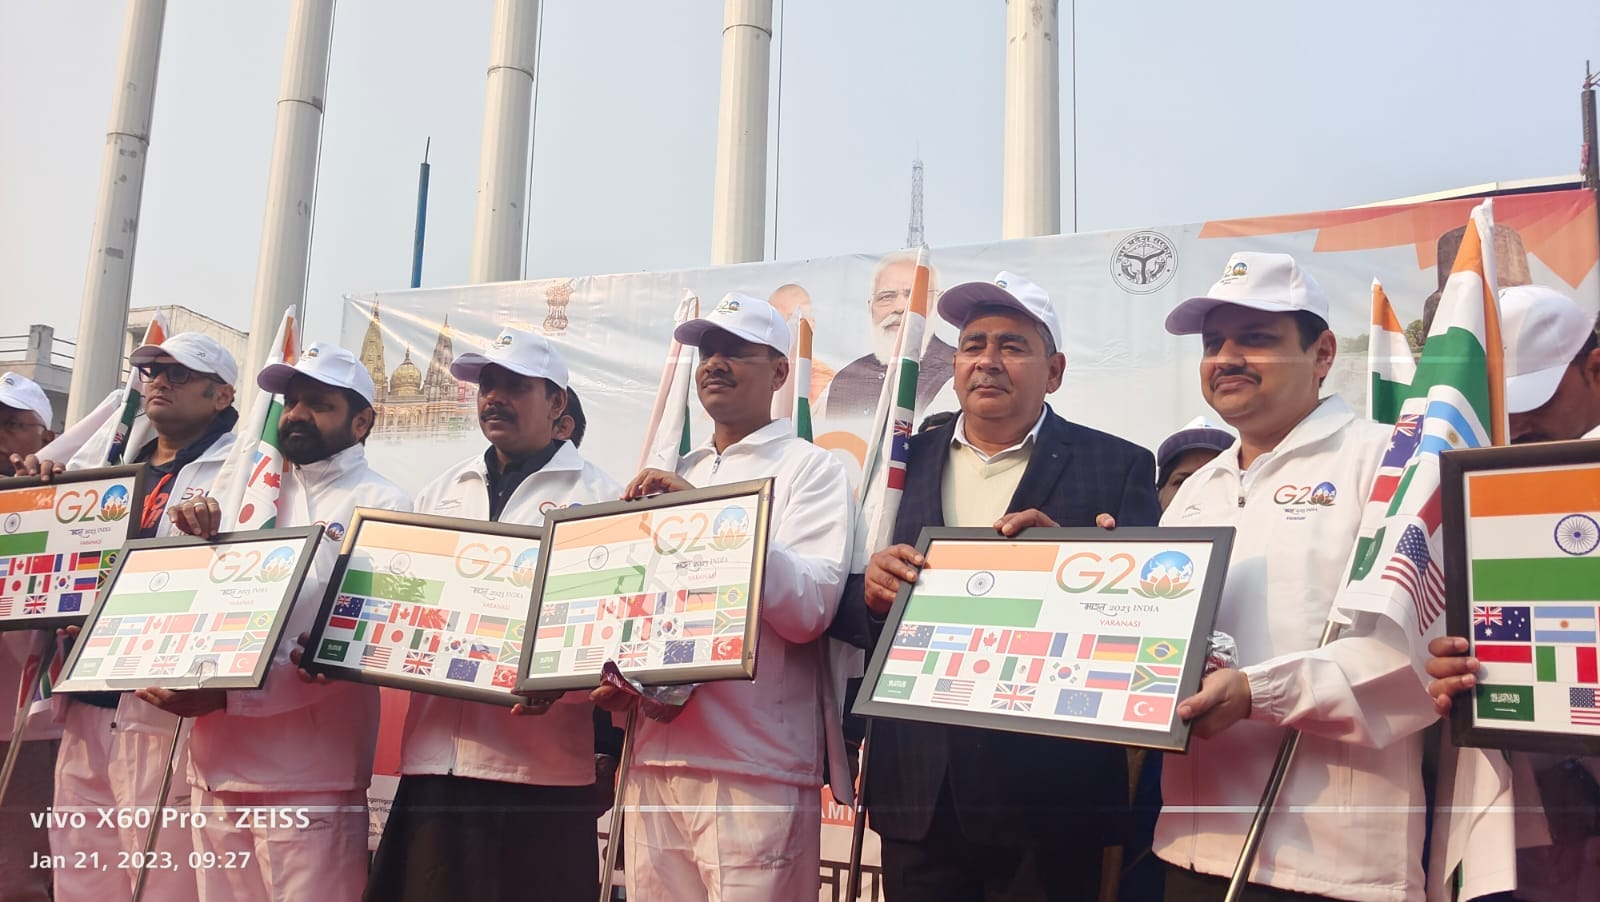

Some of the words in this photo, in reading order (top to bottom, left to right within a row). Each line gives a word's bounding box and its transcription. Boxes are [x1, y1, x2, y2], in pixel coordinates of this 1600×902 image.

[1273, 481, 1337, 507] G20
[1055, 550, 1195, 599] G20
[1109, 603, 1131, 613] 2023
[1133, 604, 1160, 613] INDIA
[1099, 618, 1142, 629] VARANASI
